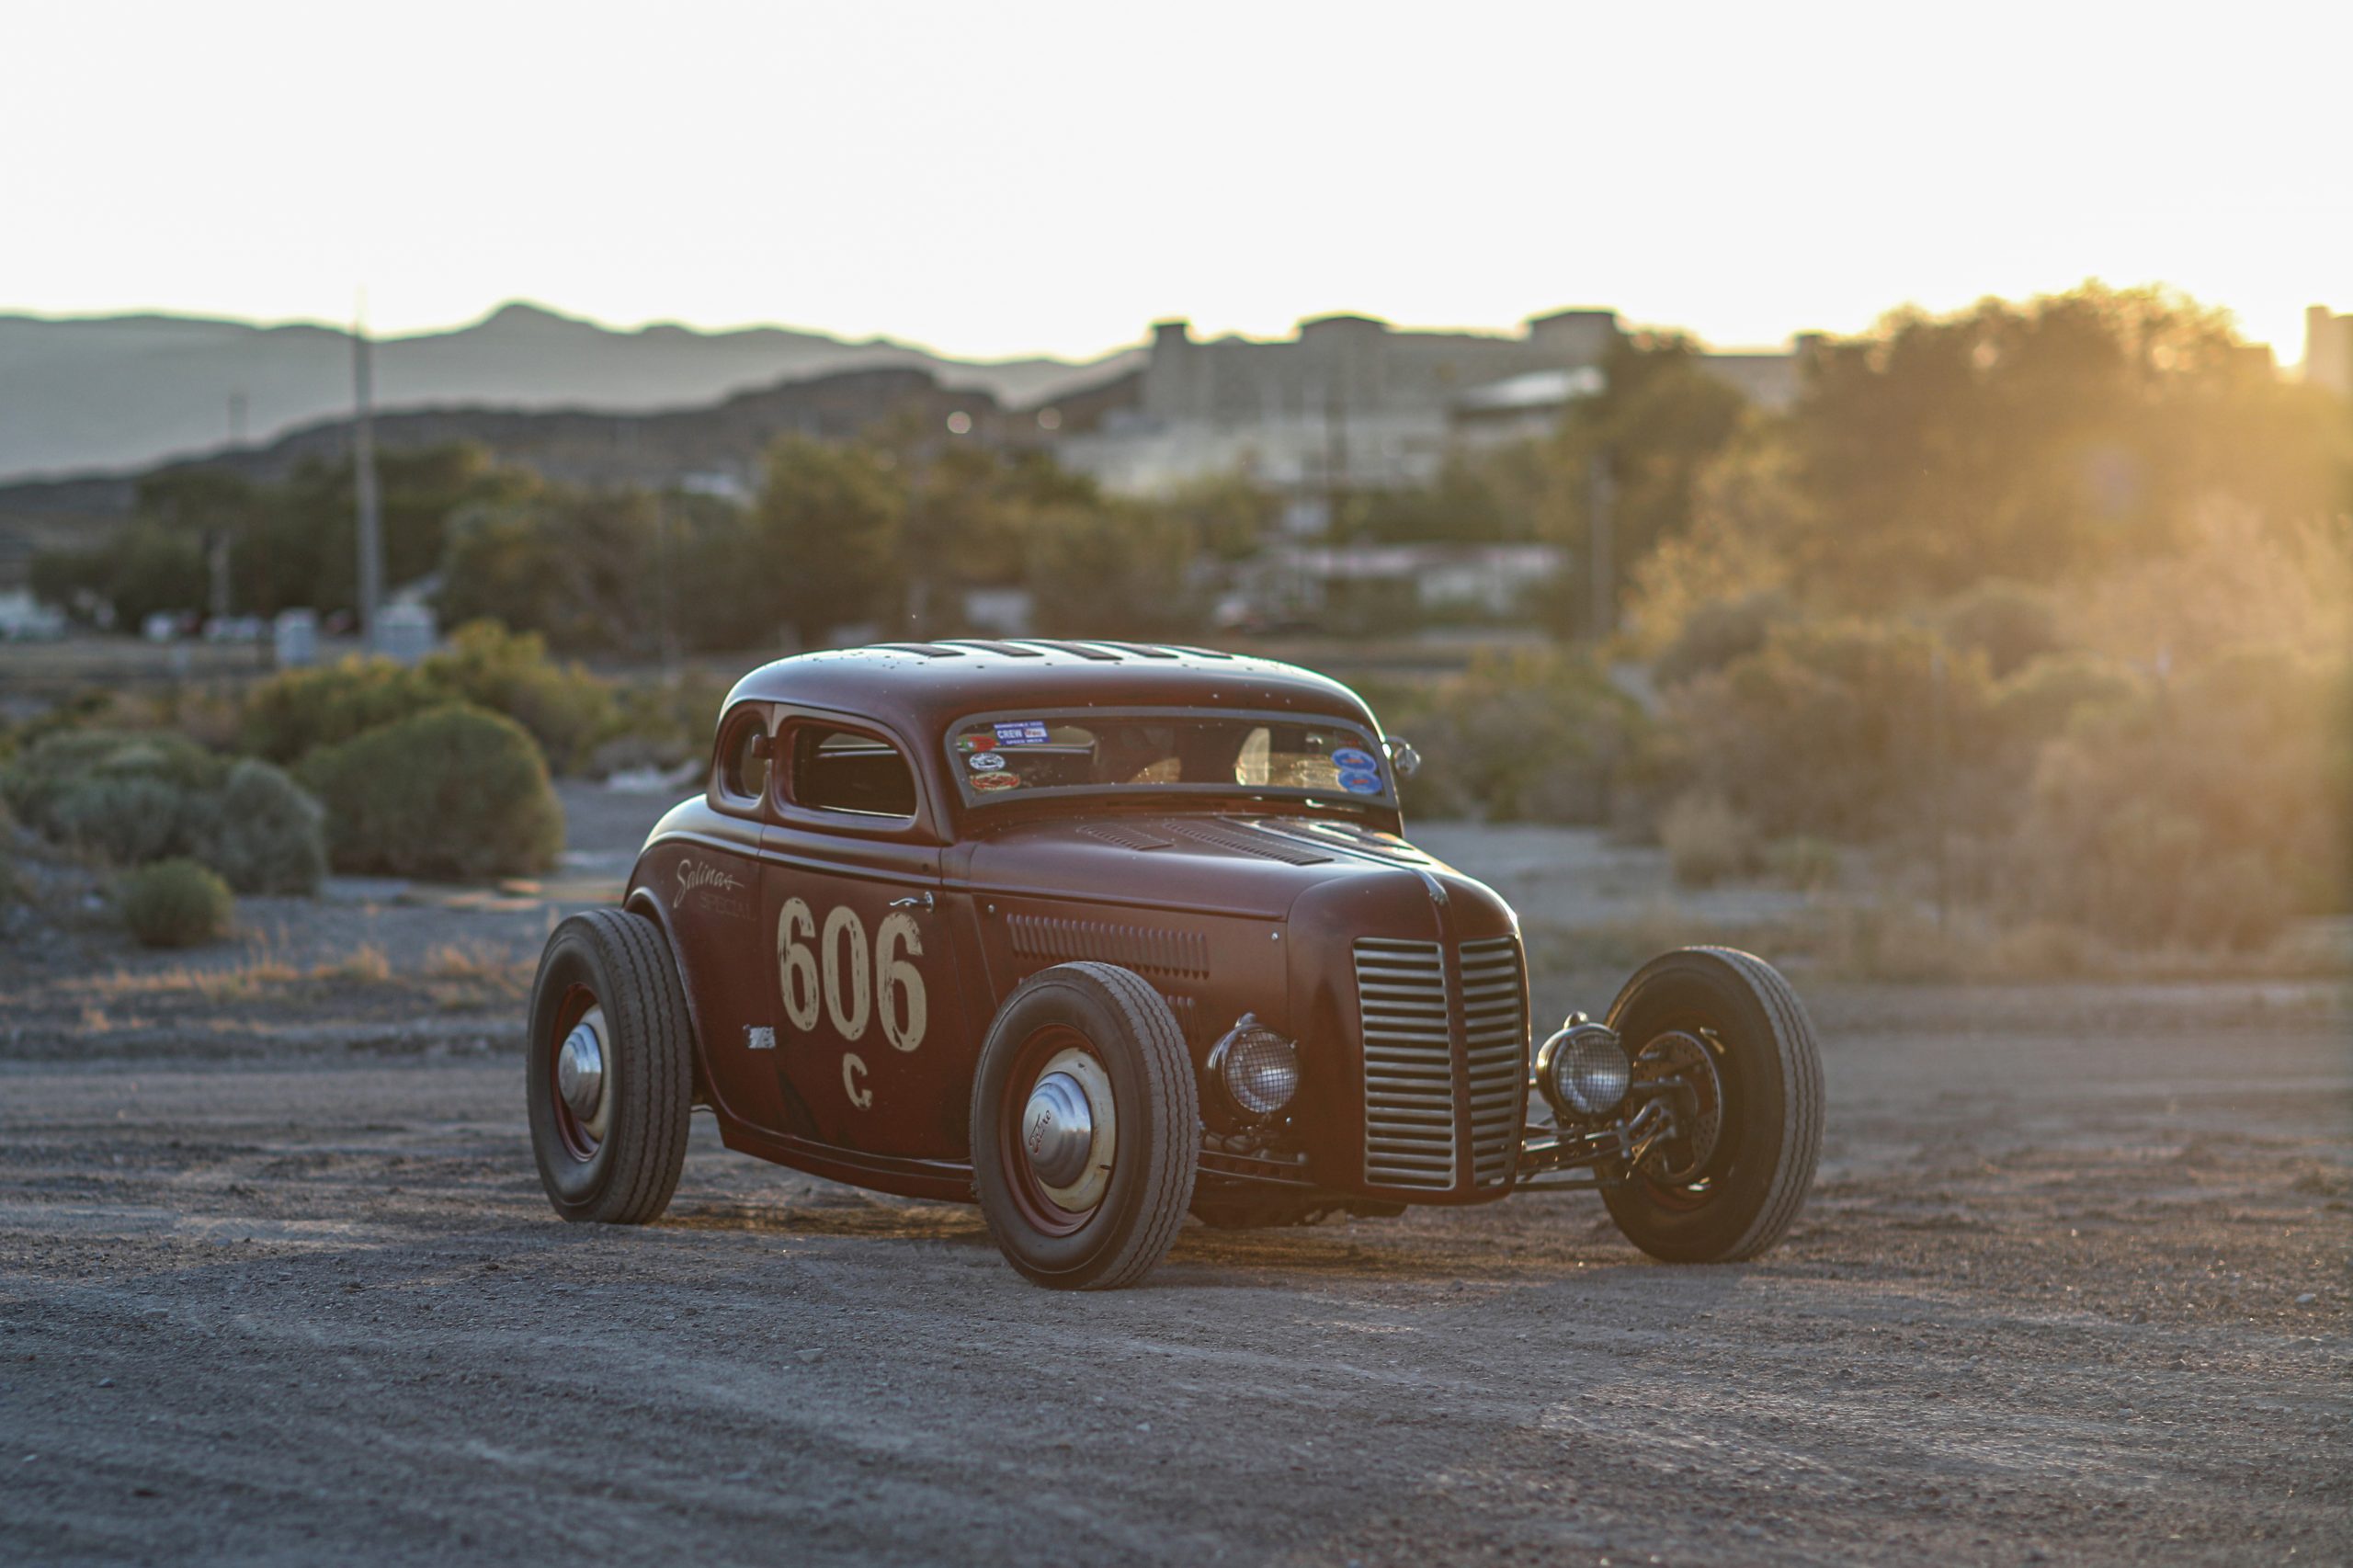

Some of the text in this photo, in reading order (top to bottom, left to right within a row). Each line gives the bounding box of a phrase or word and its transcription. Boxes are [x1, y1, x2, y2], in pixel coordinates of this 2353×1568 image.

[996, 729, 1023, 739] CREW
[673, 858, 745, 909] Salinas
[777, 897, 927, 1052] 606
